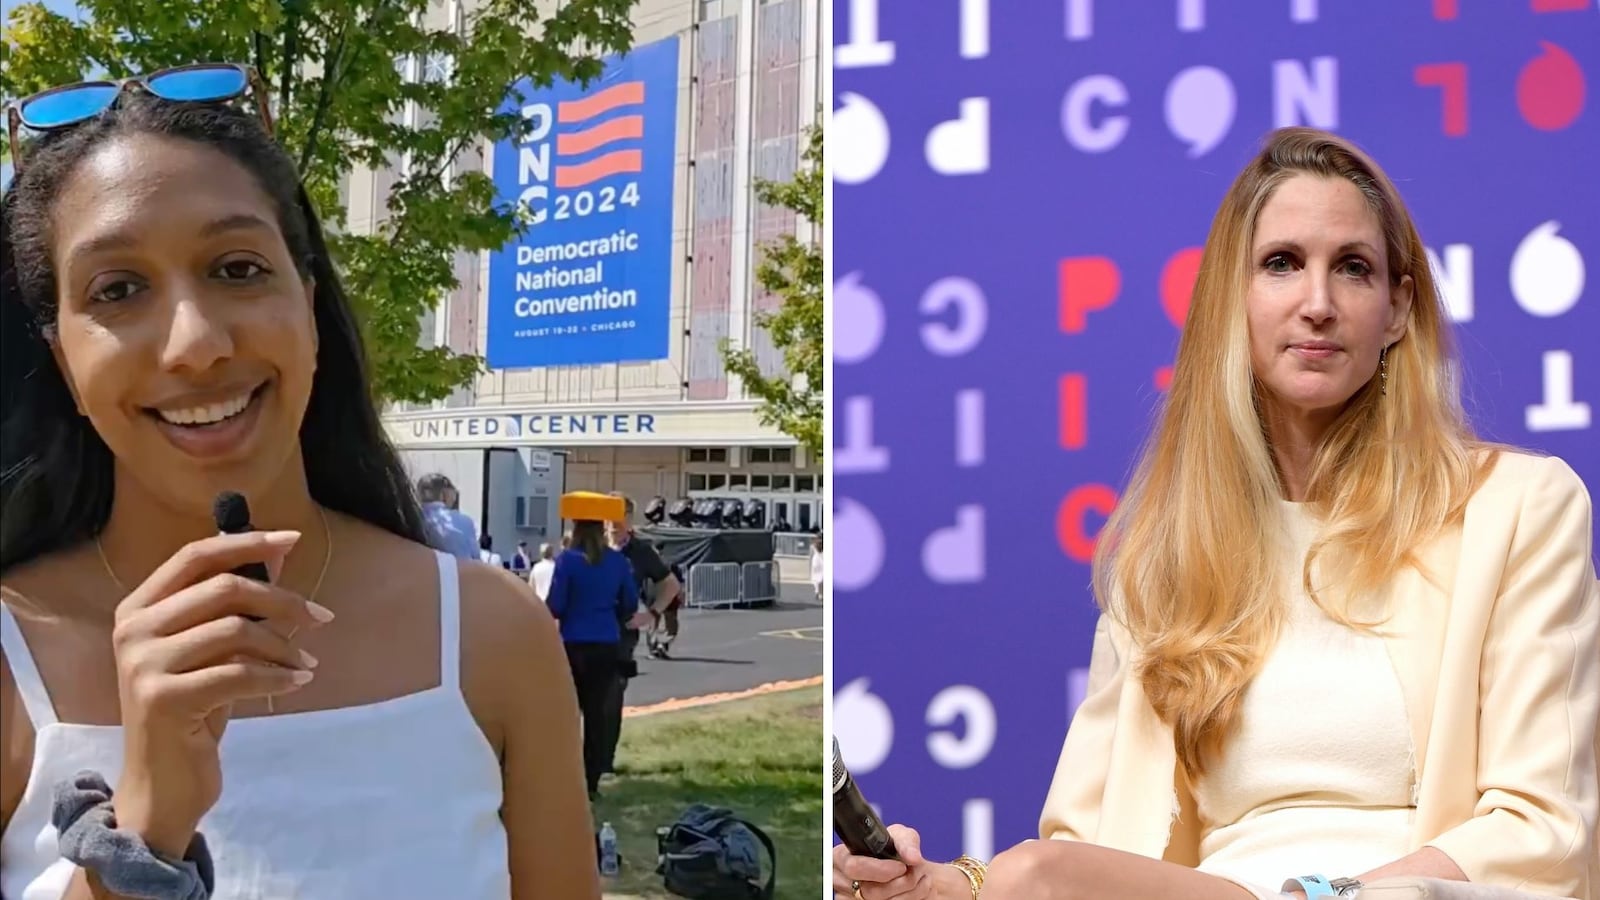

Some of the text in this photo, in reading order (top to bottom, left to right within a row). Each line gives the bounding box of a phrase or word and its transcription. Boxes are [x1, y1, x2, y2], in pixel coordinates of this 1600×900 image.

[553, 181, 640, 220] 2024
[517, 228, 638, 266] Democratic
[516, 260, 603, 293] National
[514, 288, 637, 318] Convention
[514, 327, 549, 338] AUGUST
[591, 319, 636, 332] CHICAGO
[413, 414, 655, 438] UNITED CENTER
